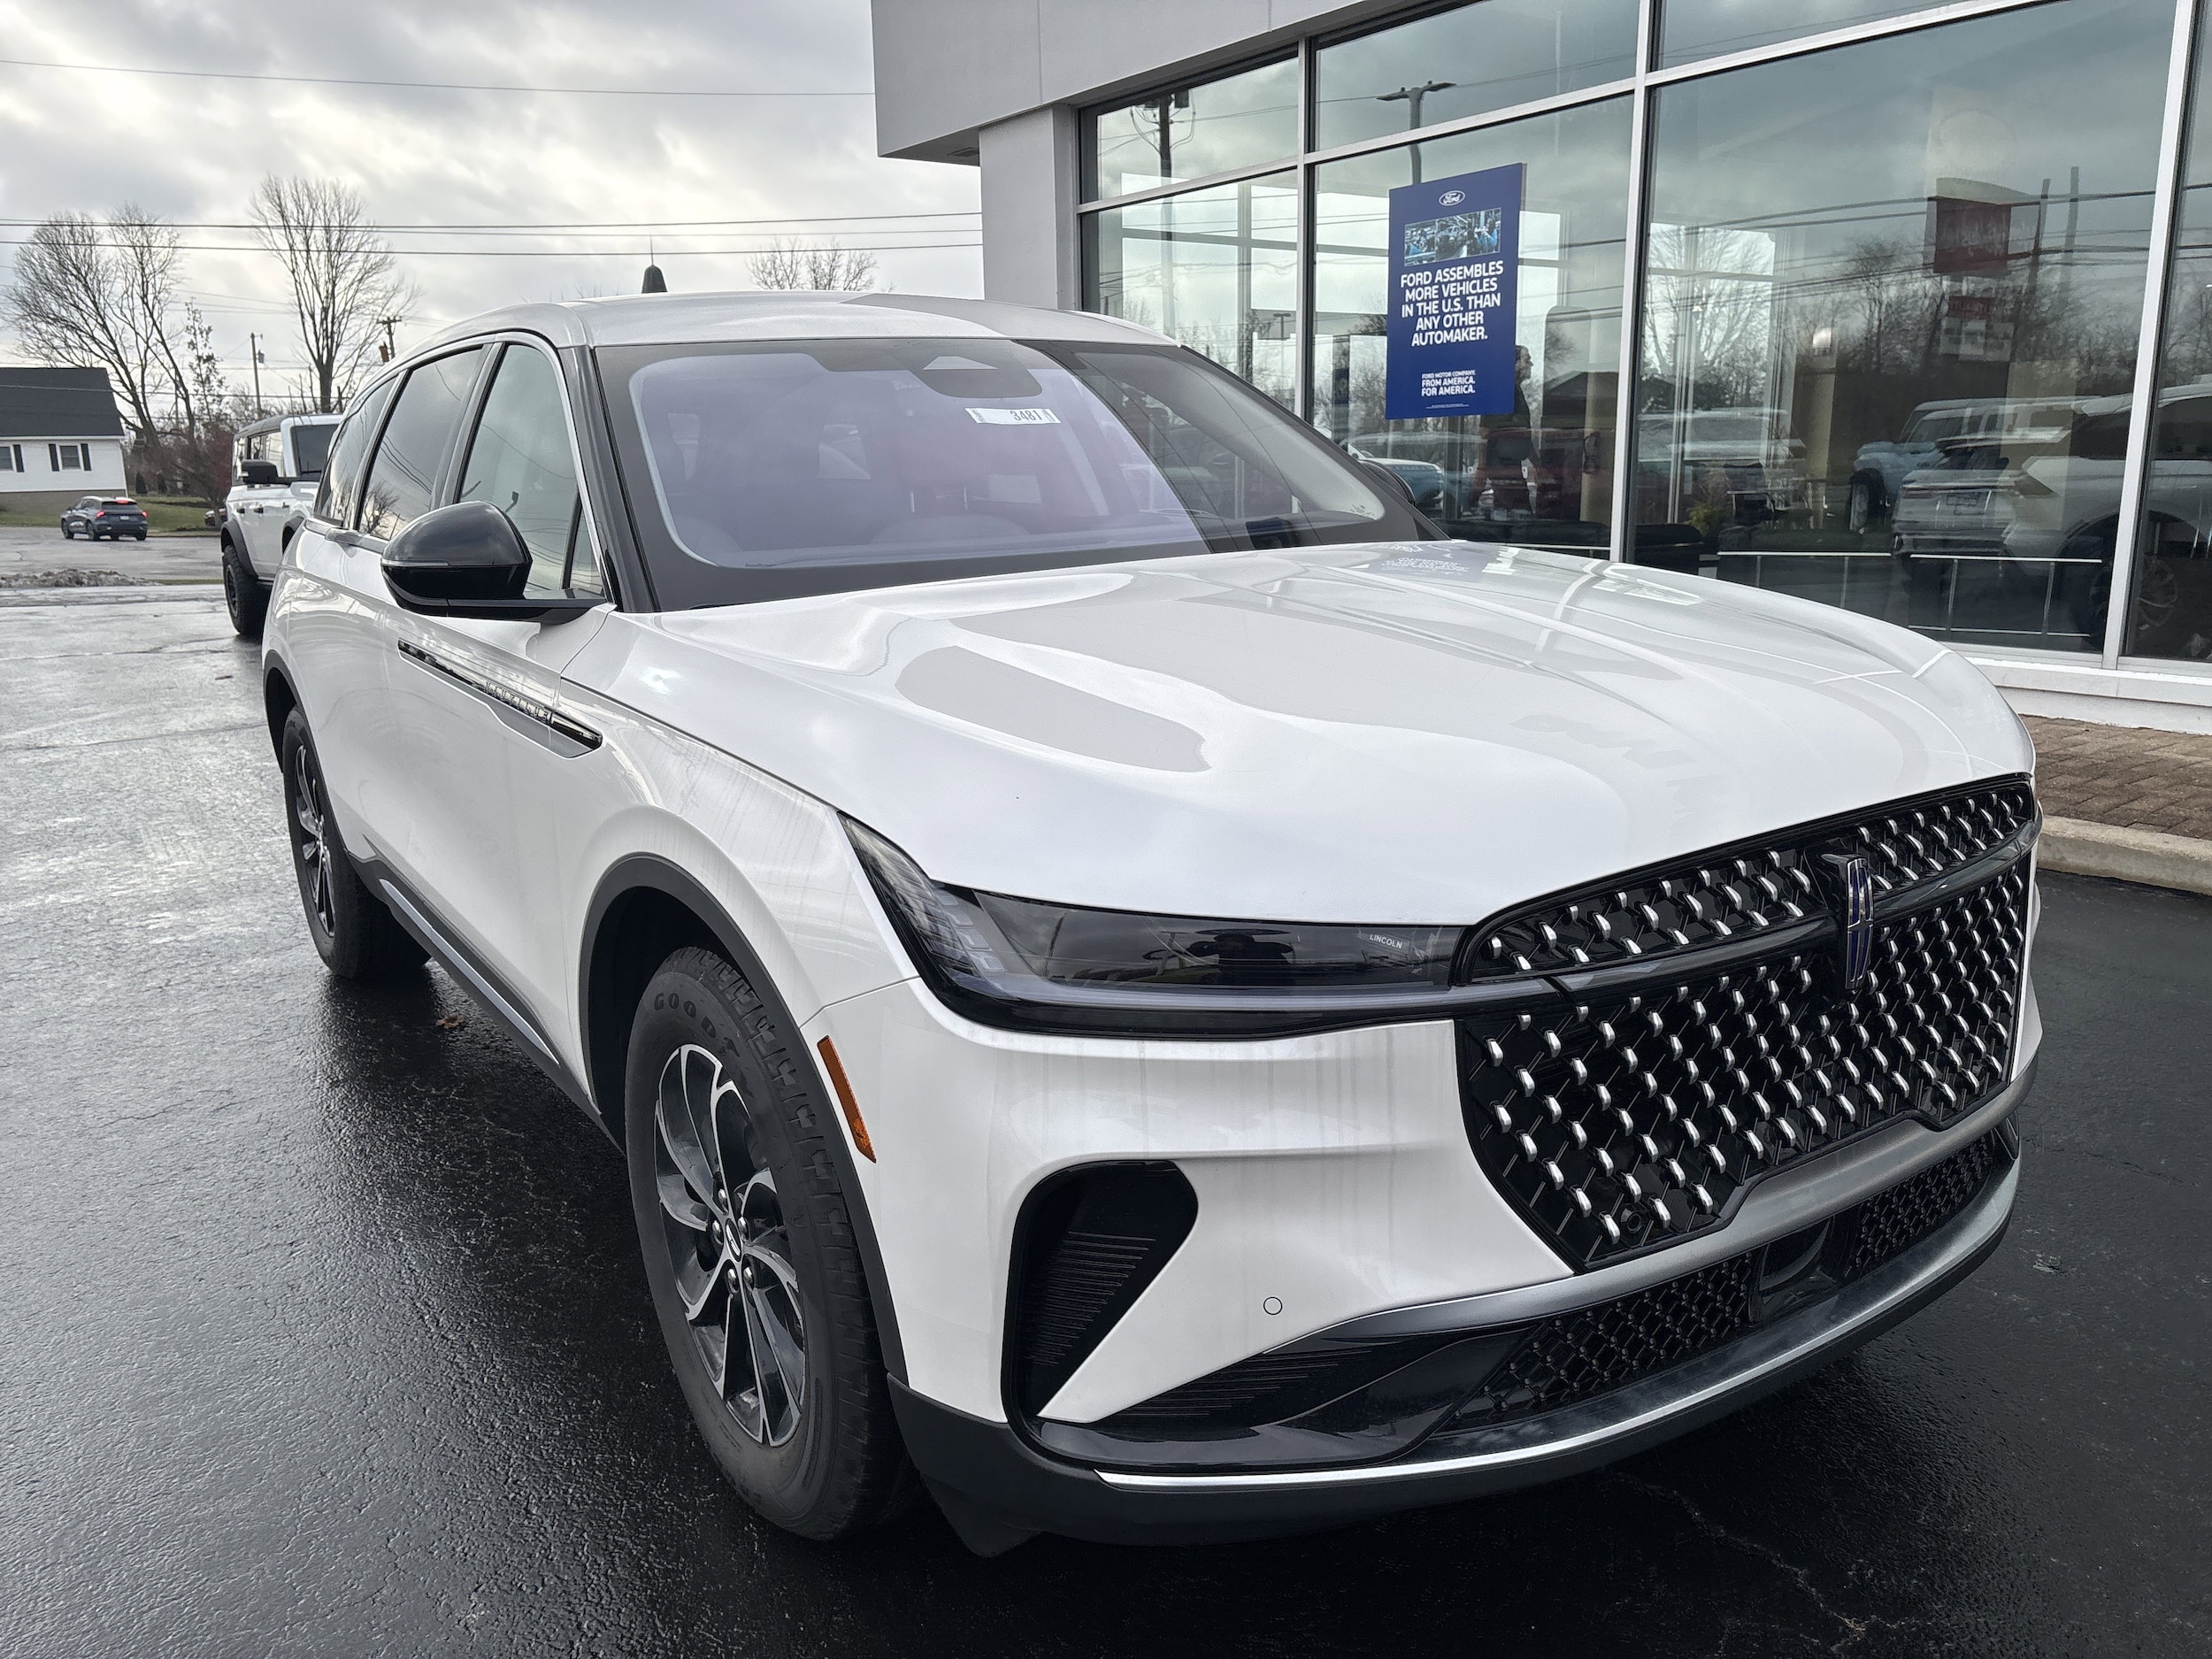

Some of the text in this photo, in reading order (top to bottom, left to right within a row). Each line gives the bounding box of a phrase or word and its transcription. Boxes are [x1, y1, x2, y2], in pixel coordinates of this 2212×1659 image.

[1441, 191, 1463, 204] Ford
[1401, 260, 1504, 288] FORD ASSEMBLES
[1405, 277, 1498, 303] MORE VEHICLES
[1402, 292, 1502, 318] IN THE U.S. THAN
[1416, 311, 1484, 331] ANY OTHER
[1411, 326, 1488, 347] AUTOMAKER.
[1421, 384, 1476, 396] FOR AMERICA.
[1422, 376, 1476, 388] FROM AMERICA.
[1010, 410, 1042, 421] 3481
[1369, 933, 1402, 949] LINCOLN
